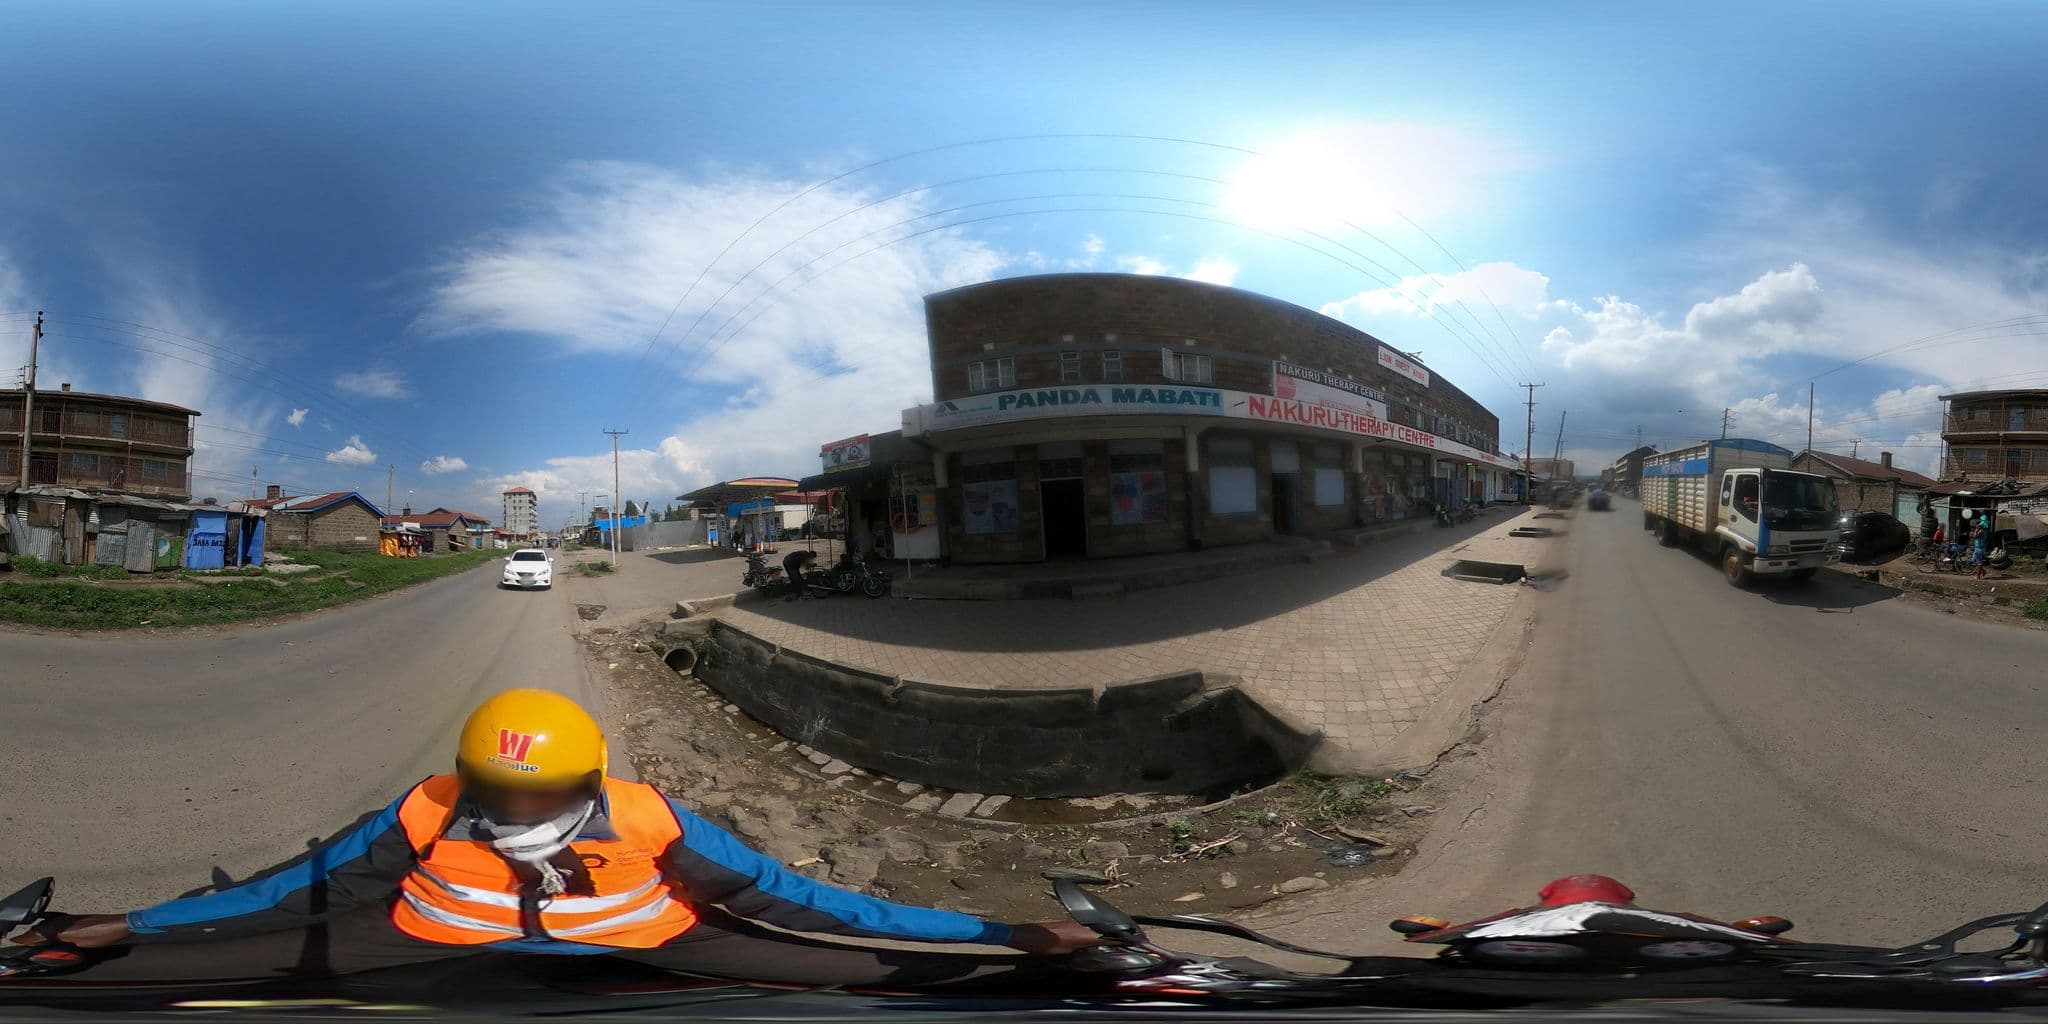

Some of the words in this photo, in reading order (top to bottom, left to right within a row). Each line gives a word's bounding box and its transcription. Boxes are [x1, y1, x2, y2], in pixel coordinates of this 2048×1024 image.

[998, 389, 1103, 411] PANDA
[1111, 388, 1221, 407] MABATI
[1279, 363, 1320, 382] NAKURU
[1323, 373, 1359, 393] THERAPY
[1360, 385, 1385, 403] CENTRE
[1249, 395, 1339, 428] NAKURU
[1341, 412, 1395, 439] THERAPY
[1398, 425, 1435, 448] CENTRE
